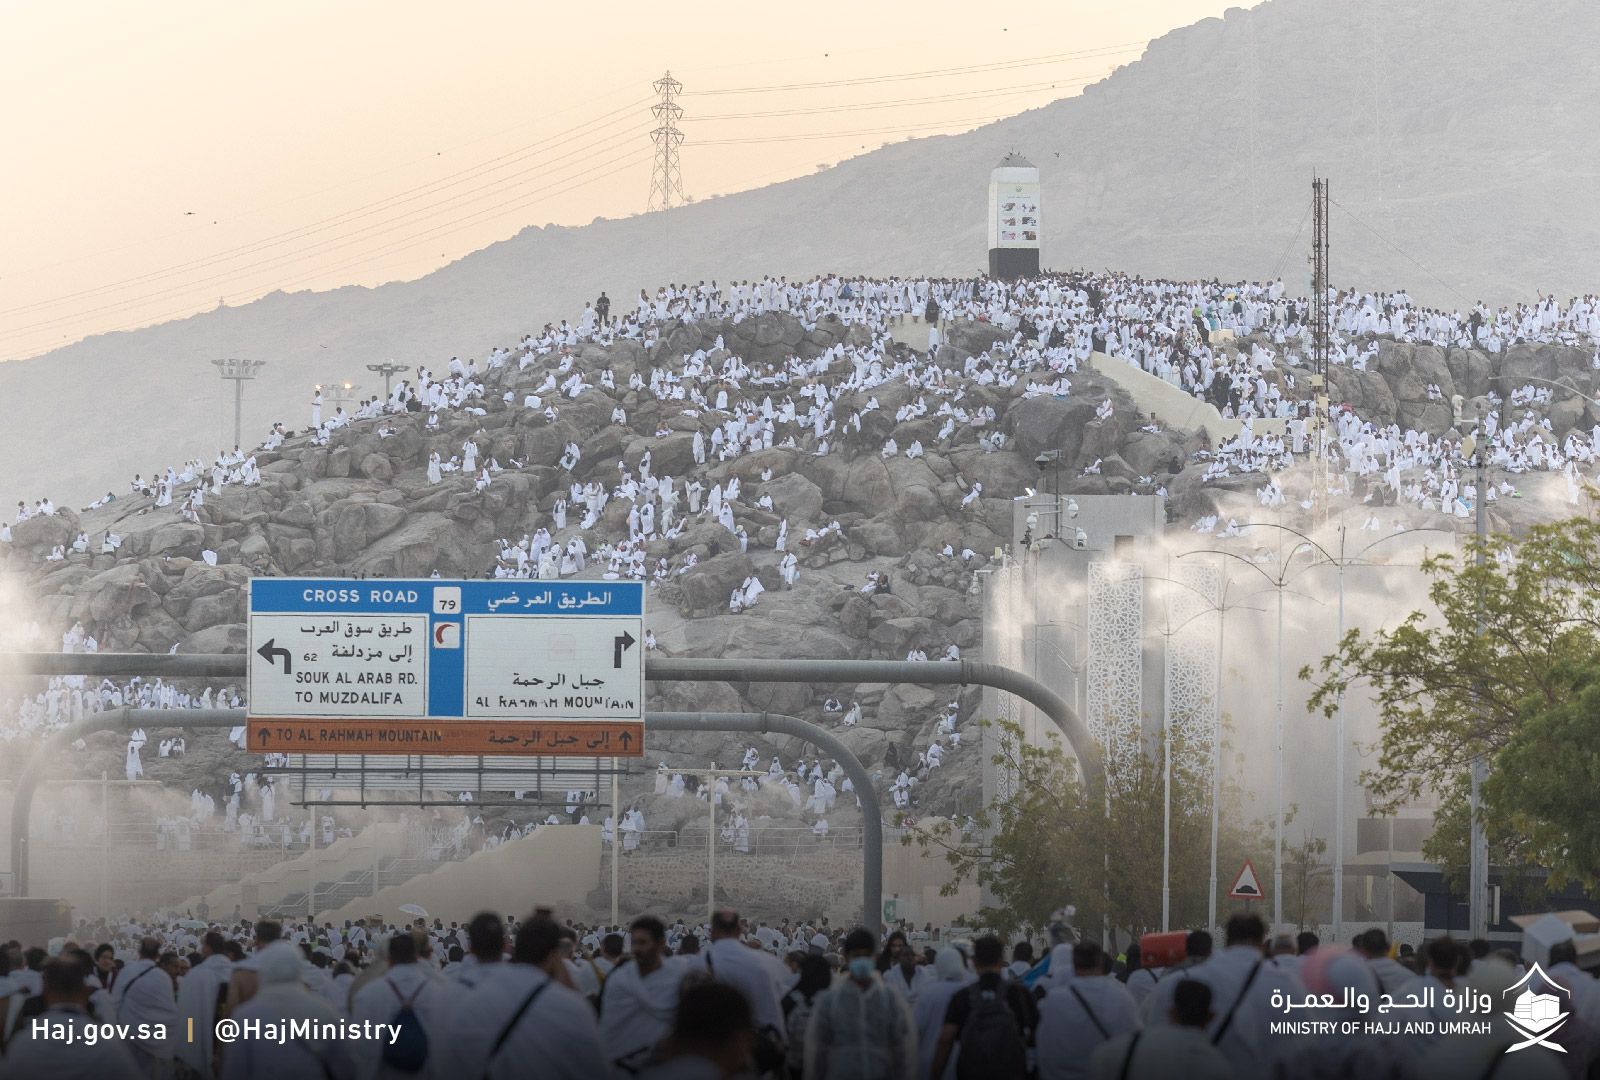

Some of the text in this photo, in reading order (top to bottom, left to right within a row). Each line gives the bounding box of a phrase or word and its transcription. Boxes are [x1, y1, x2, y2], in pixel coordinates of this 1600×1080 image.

[303, 589, 418, 603] CROSS ROAD
[487, 591, 612, 611] الطريق العرضي
[439, 600, 456, 610] 79
[300, 620, 412, 638] طريق سوق العرب
[303, 653, 318, 662] 62
[331, 644, 412, 663] إلى مزدلفة
[296, 671, 418, 685] SOUK AL ARAB RD.
[512, 672, 605, 690] جبل الرحمة
[296, 691, 403, 705] TO MUZDALIFA
[276, 728, 442, 743] TO AL RAHMAH MOUNTAIN
[488, 730, 610, 749] إلى جبل الرحمة
